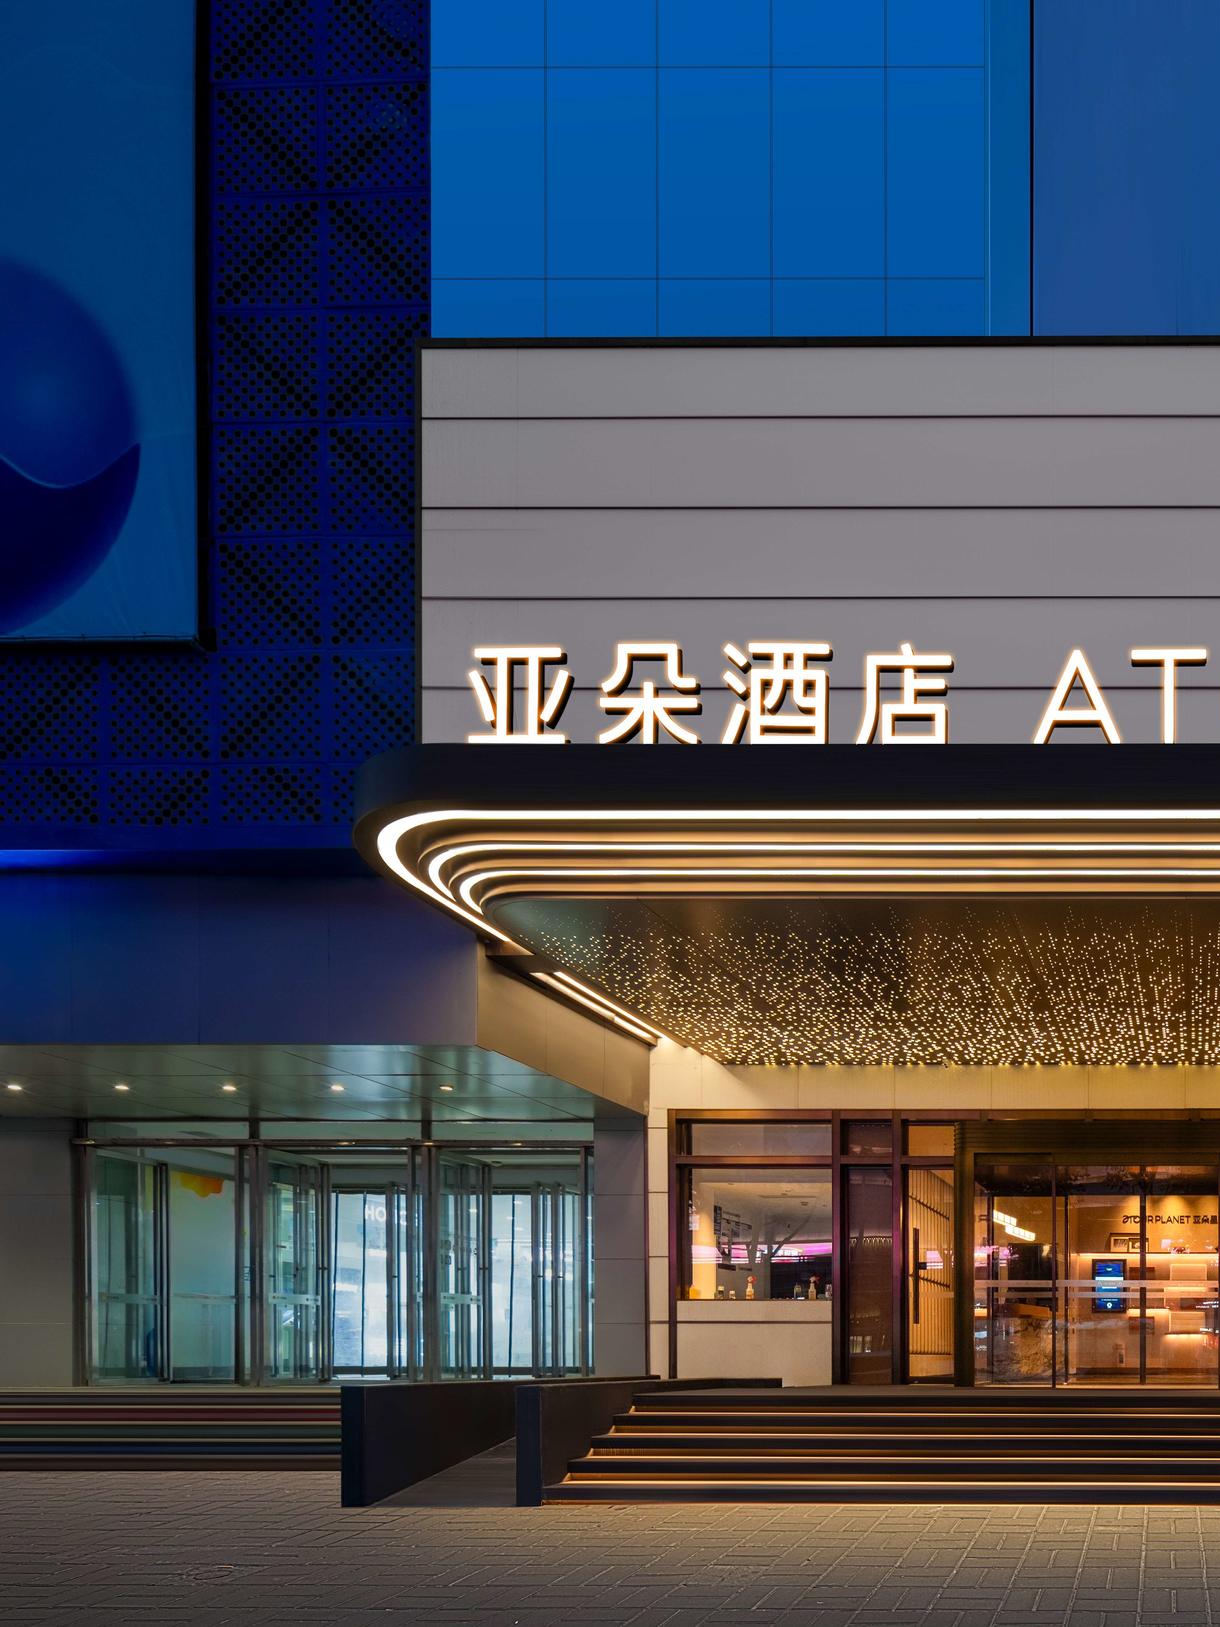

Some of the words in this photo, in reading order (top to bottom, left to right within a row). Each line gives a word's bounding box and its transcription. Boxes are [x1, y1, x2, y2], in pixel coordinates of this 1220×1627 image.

[467, 642, 954, 745] 亚朵酒店
[1155, 1215, 1191, 1225] PLANET
